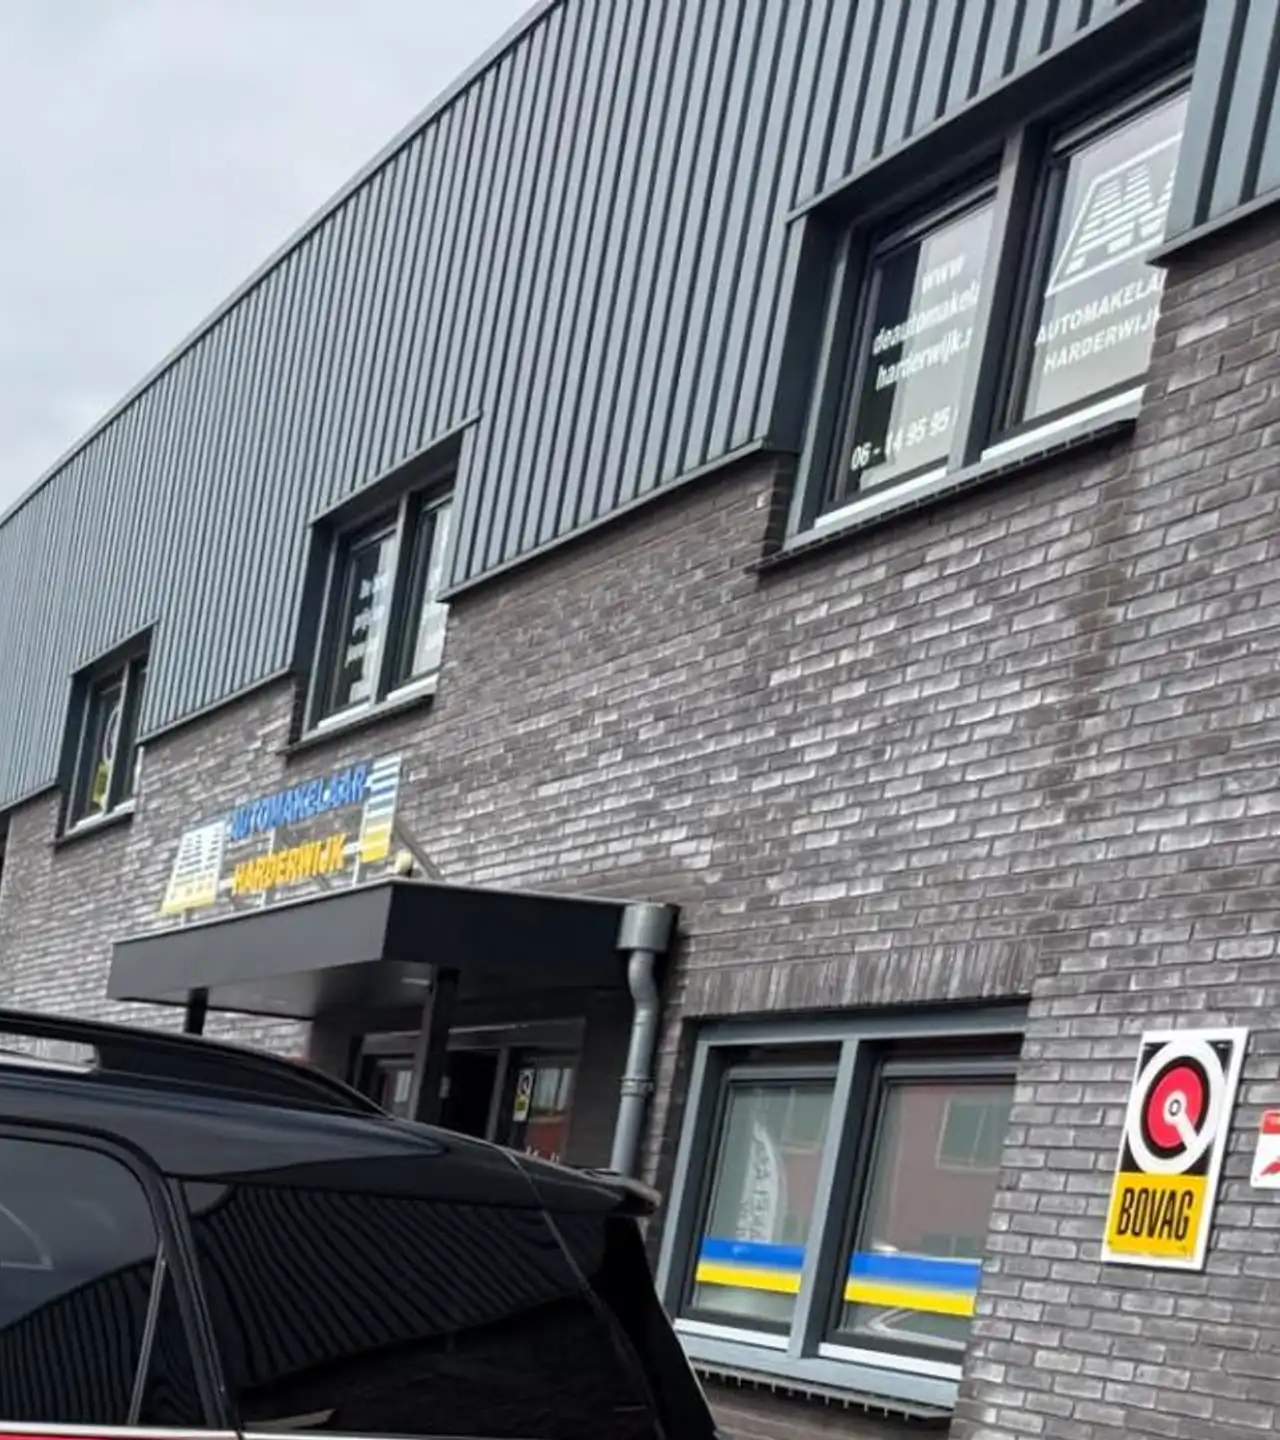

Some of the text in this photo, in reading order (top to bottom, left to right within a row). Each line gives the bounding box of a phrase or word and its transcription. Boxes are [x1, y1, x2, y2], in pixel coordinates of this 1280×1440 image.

[1034, 271, 1165, 346] AUTOMAKELA
[228, 765, 370, 841] AUTOMAKELAAR
[230, 832, 347, 897] HARDERWIJK
[1117, 1187, 1194, 1240] BOVAG
